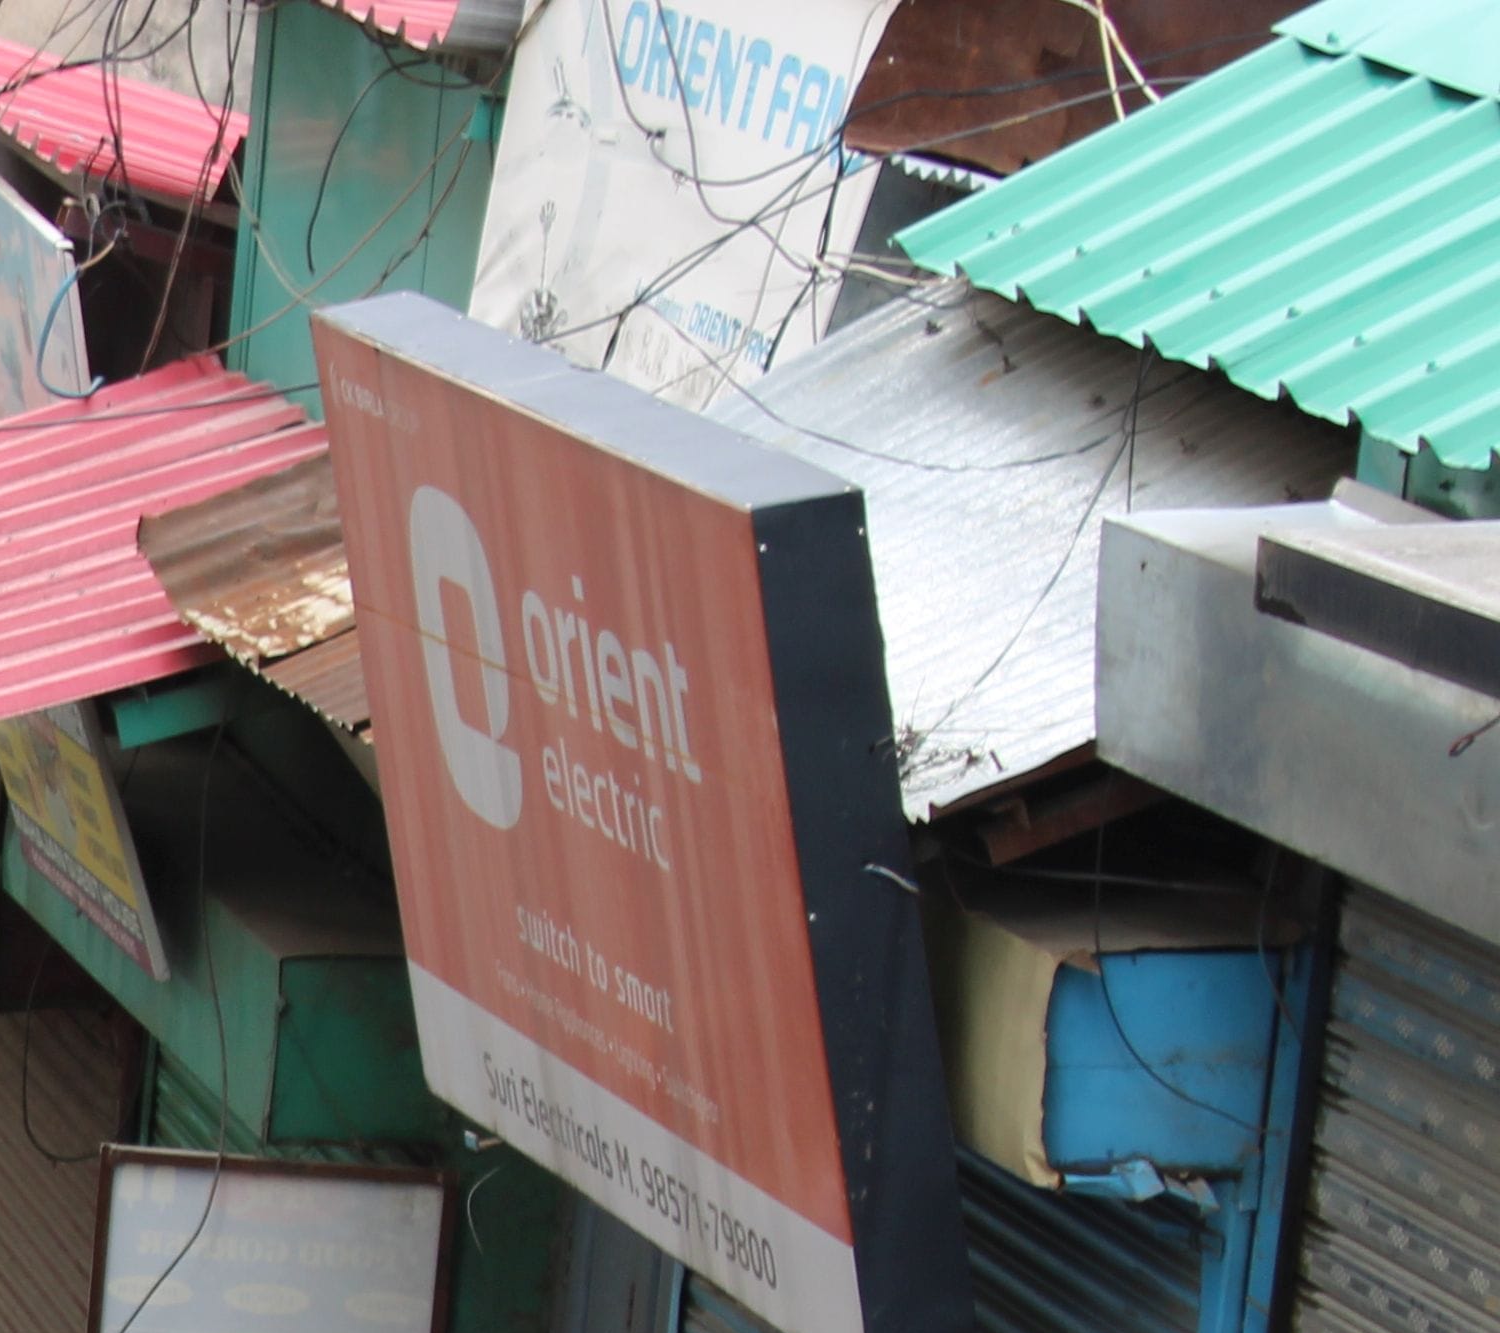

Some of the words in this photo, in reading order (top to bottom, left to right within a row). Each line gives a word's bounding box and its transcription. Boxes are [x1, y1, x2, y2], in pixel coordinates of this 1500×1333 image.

[618, 0, 773, 131] ORIENT
[521, 575, 701, 785] orient
[542, 737, 670, 873] electric
[517, 905, 581, 978] switch
[586, 941, 609, 993] to
[614, 965, 674, 1035] smart
[482, 1052, 520, 1116] Suri
[615, 1139, 640, 1198] M.
[642, 1157, 777, 1290] 98571-79800
